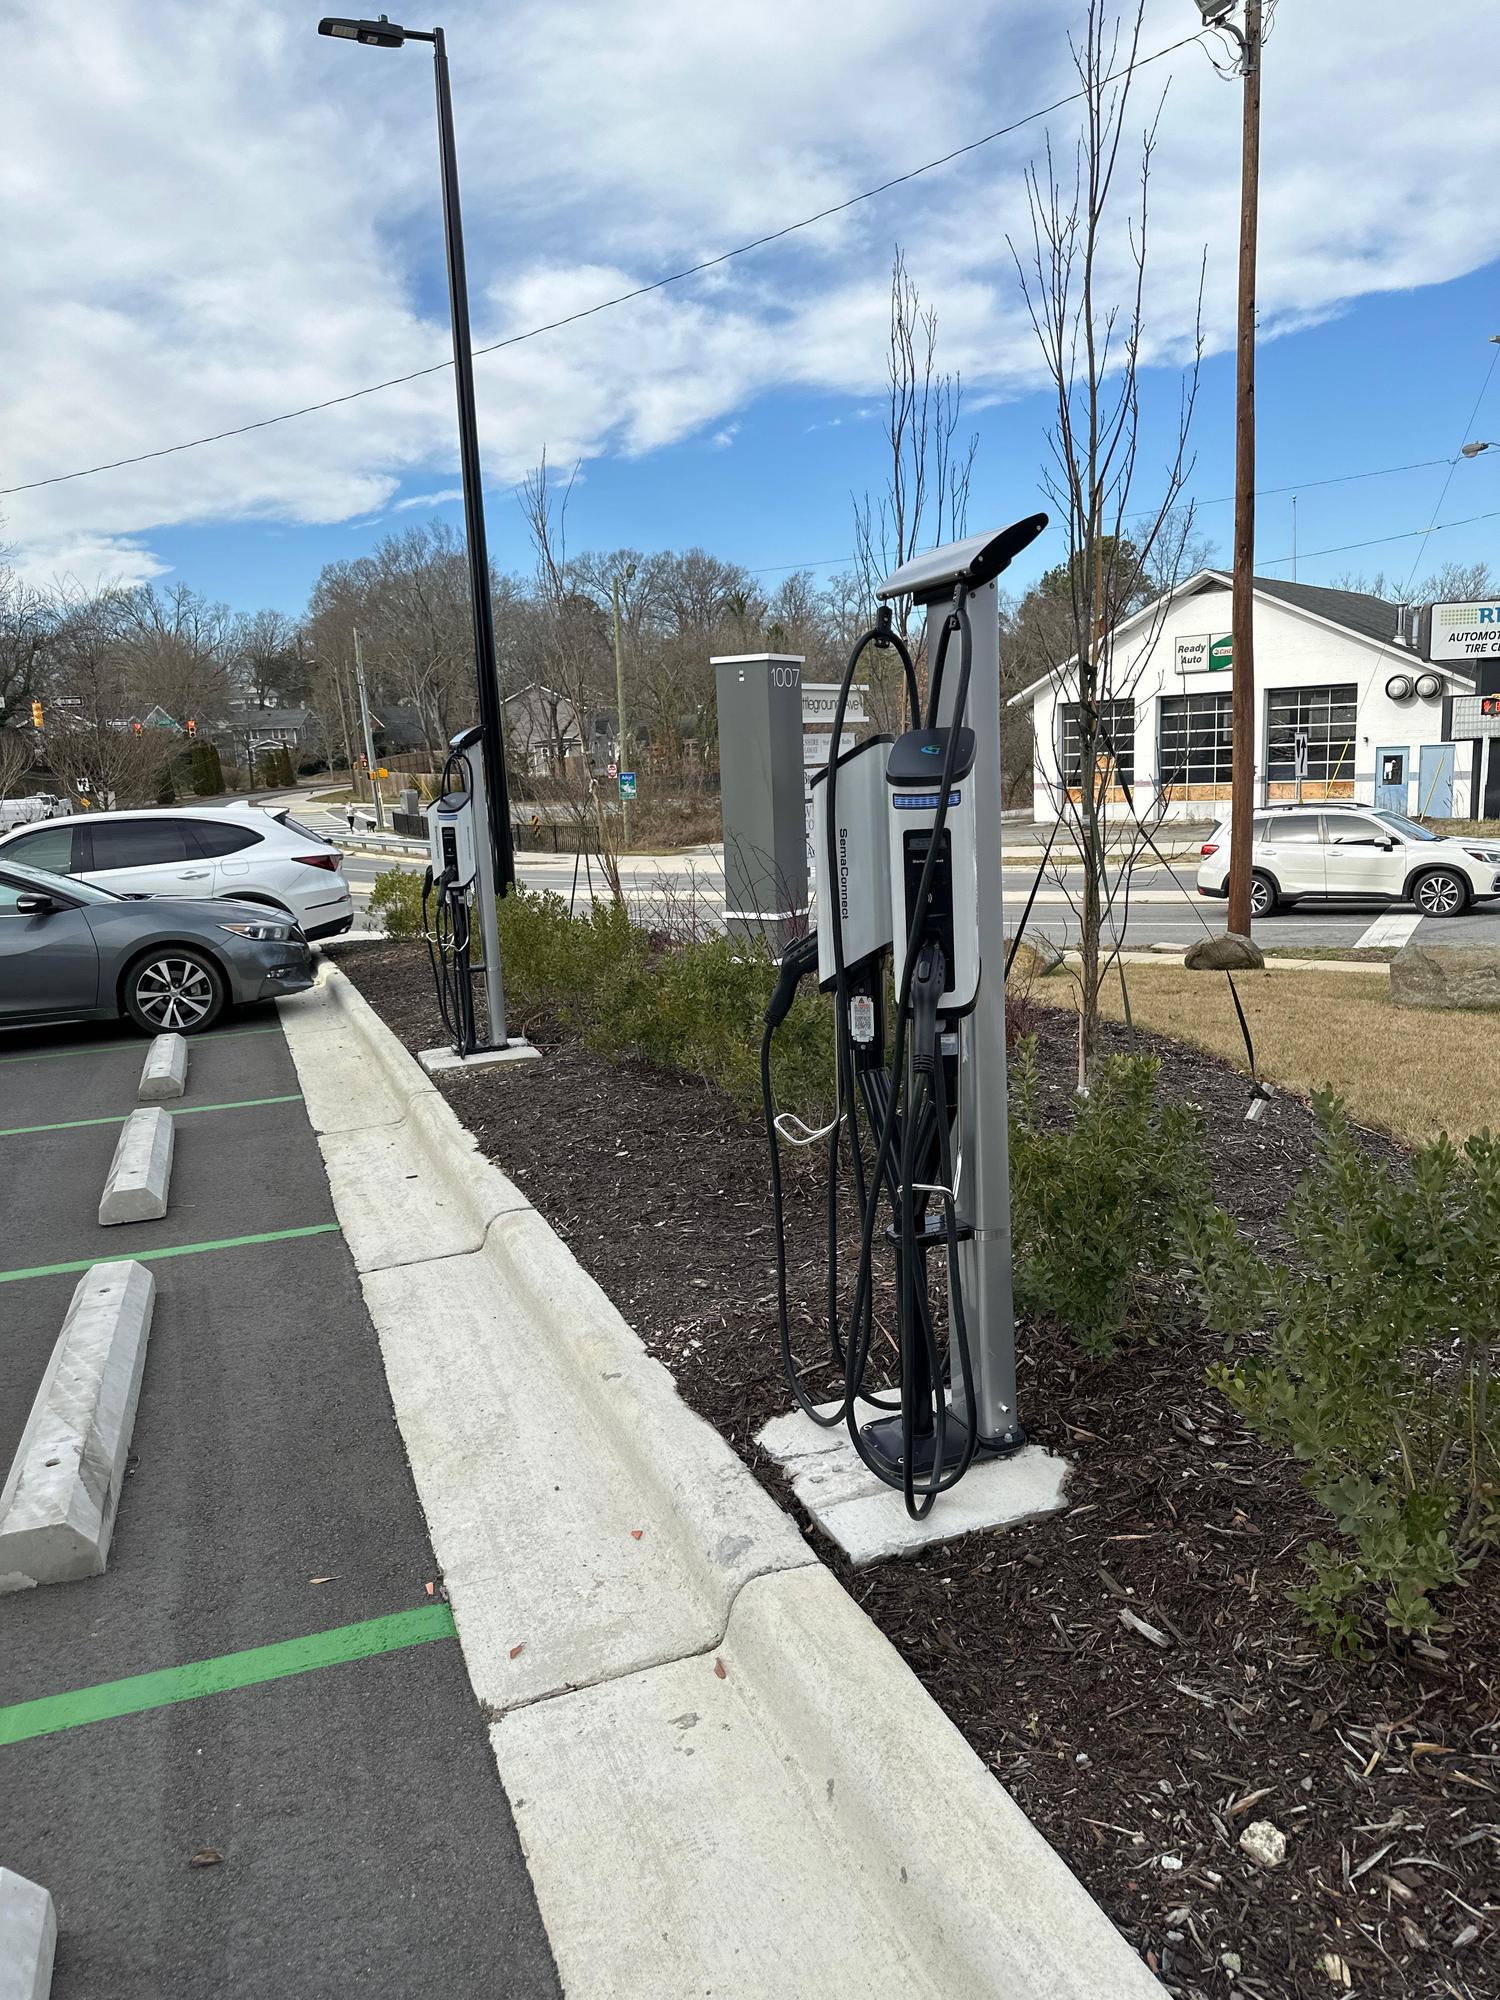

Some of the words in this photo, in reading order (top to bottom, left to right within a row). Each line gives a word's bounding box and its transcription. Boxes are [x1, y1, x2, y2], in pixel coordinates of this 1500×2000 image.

[1178, 644, 1206, 654] Ready
[1465, 643, 1488, 653] TIRE
[1181, 655, 1202, 665] Auto
[770, 667, 800, 687] 1007
[839, 828, 849, 920] SemaConnect
